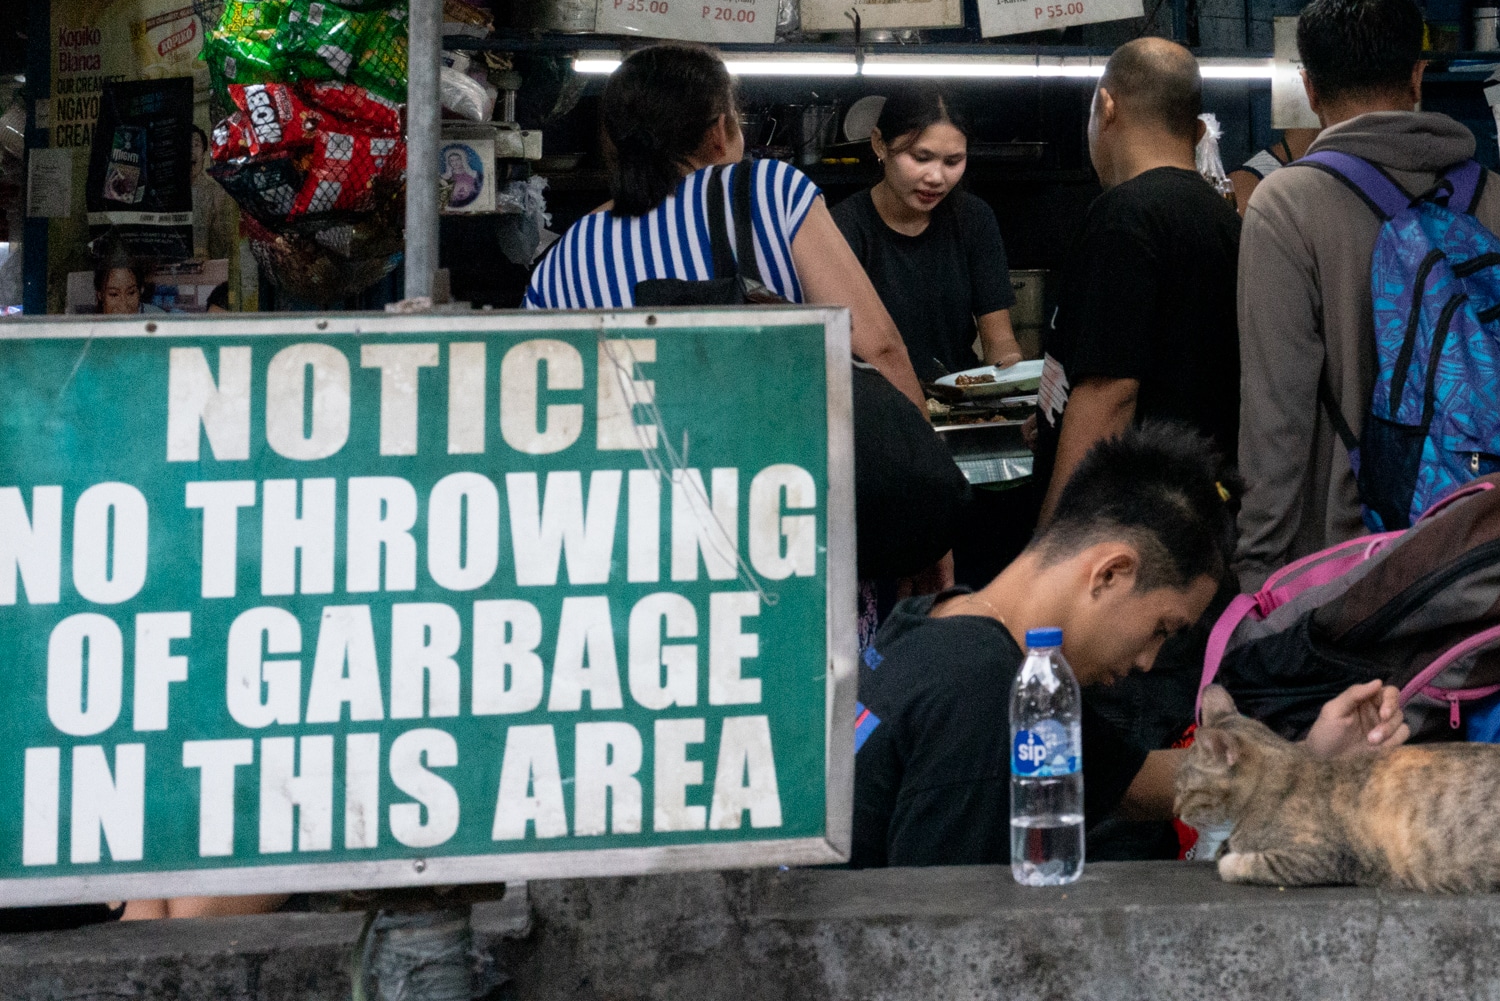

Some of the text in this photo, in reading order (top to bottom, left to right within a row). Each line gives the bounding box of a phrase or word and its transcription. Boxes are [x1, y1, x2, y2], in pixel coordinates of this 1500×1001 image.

[58, 26, 102, 51] Kopiko
[160, 26, 194, 55] KOPIKO
[702, 6, 756, 25] P 20.00
[1034, 1, 1085, 20] P 55.00
[57, 79, 76, 95] OUR
[58, 53, 102, 73] Blanca
[166, 337, 659, 463] NOTICE
[0, 481, 150, 606] NO
[185, 463, 817, 600] THROWING
[45, 611, 192, 737] OF
[226, 591, 763, 730] GARBAGE
[183, 714, 784, 859] THIS AREA
[1018, 737, 1047, 767] sip
[22, 742, 146, 866] IN
